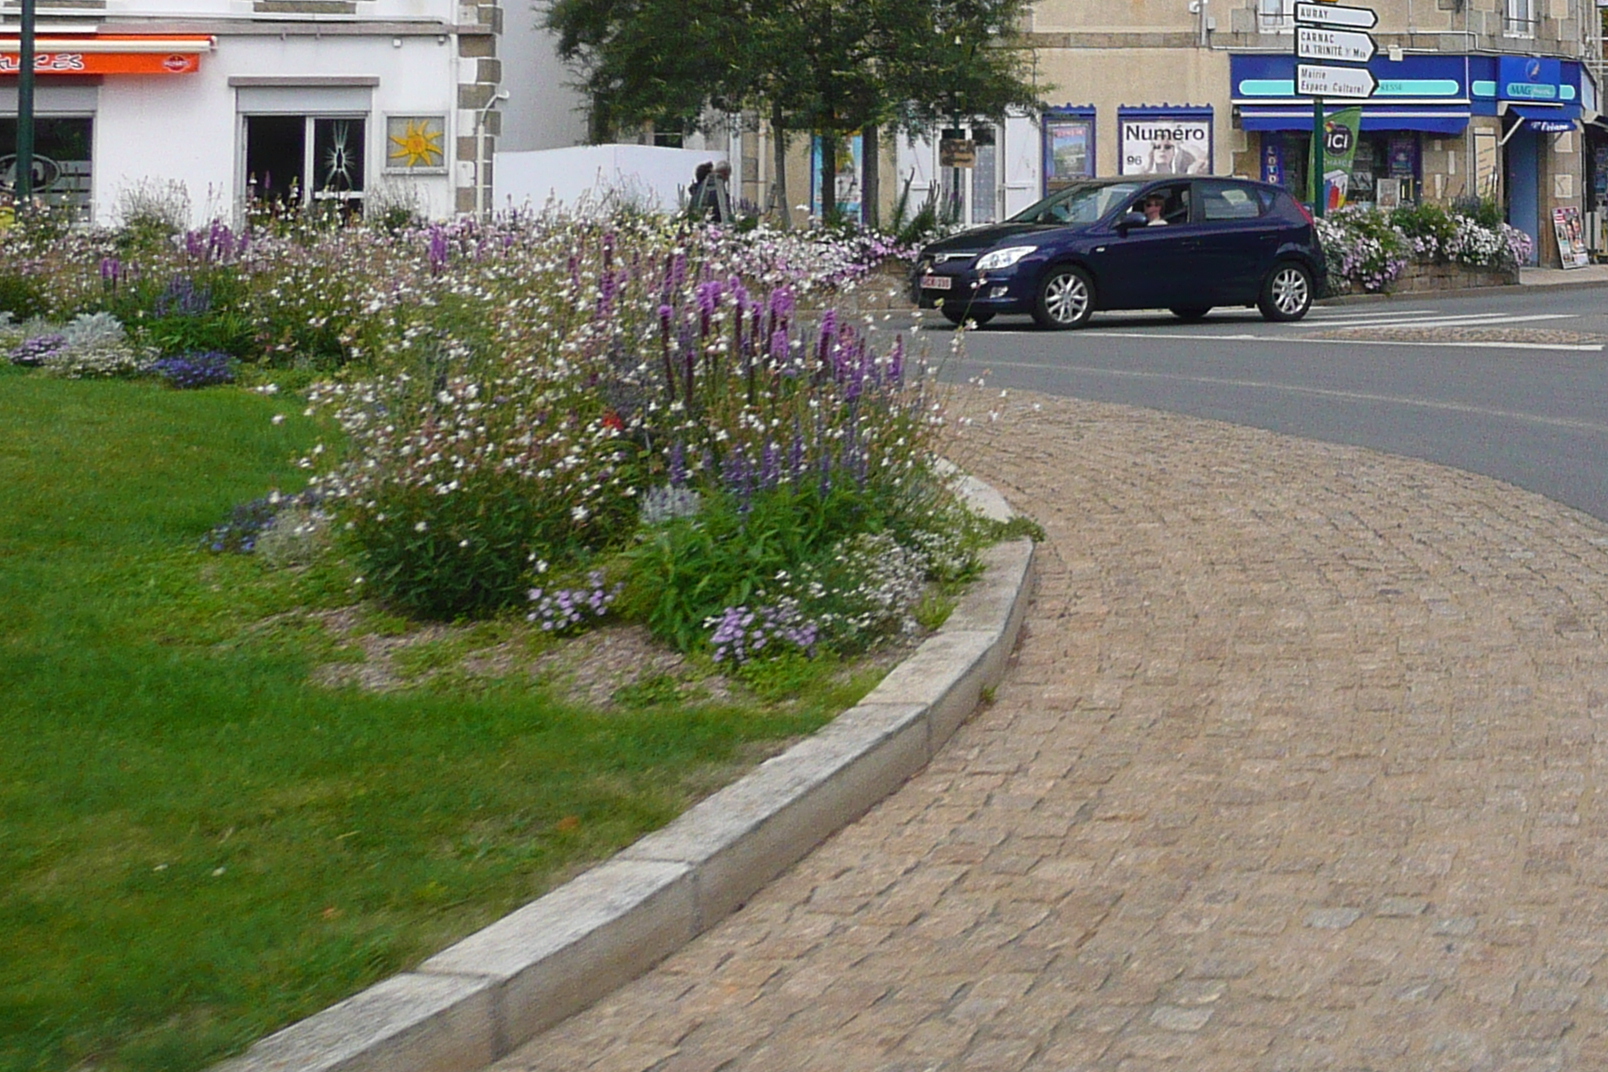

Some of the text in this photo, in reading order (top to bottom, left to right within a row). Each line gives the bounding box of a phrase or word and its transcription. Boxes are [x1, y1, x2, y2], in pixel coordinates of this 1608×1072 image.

[1300, 7, 1328, 19] AURAY
[1300, 31, 1335, 44] CARNAC
[1300, 43, 1310, 54] LA
[1314, 44, 1342, 57] TRINITÉ
[1301, 68, 1326, 79] Mairie
[1301, 80, 1365, 94] Espace Culturel
[1126, 125, 1205, 142] Numéro
[1327, 134, 1349, 148] ICI
[1126, 154, 1143, 167] 96
